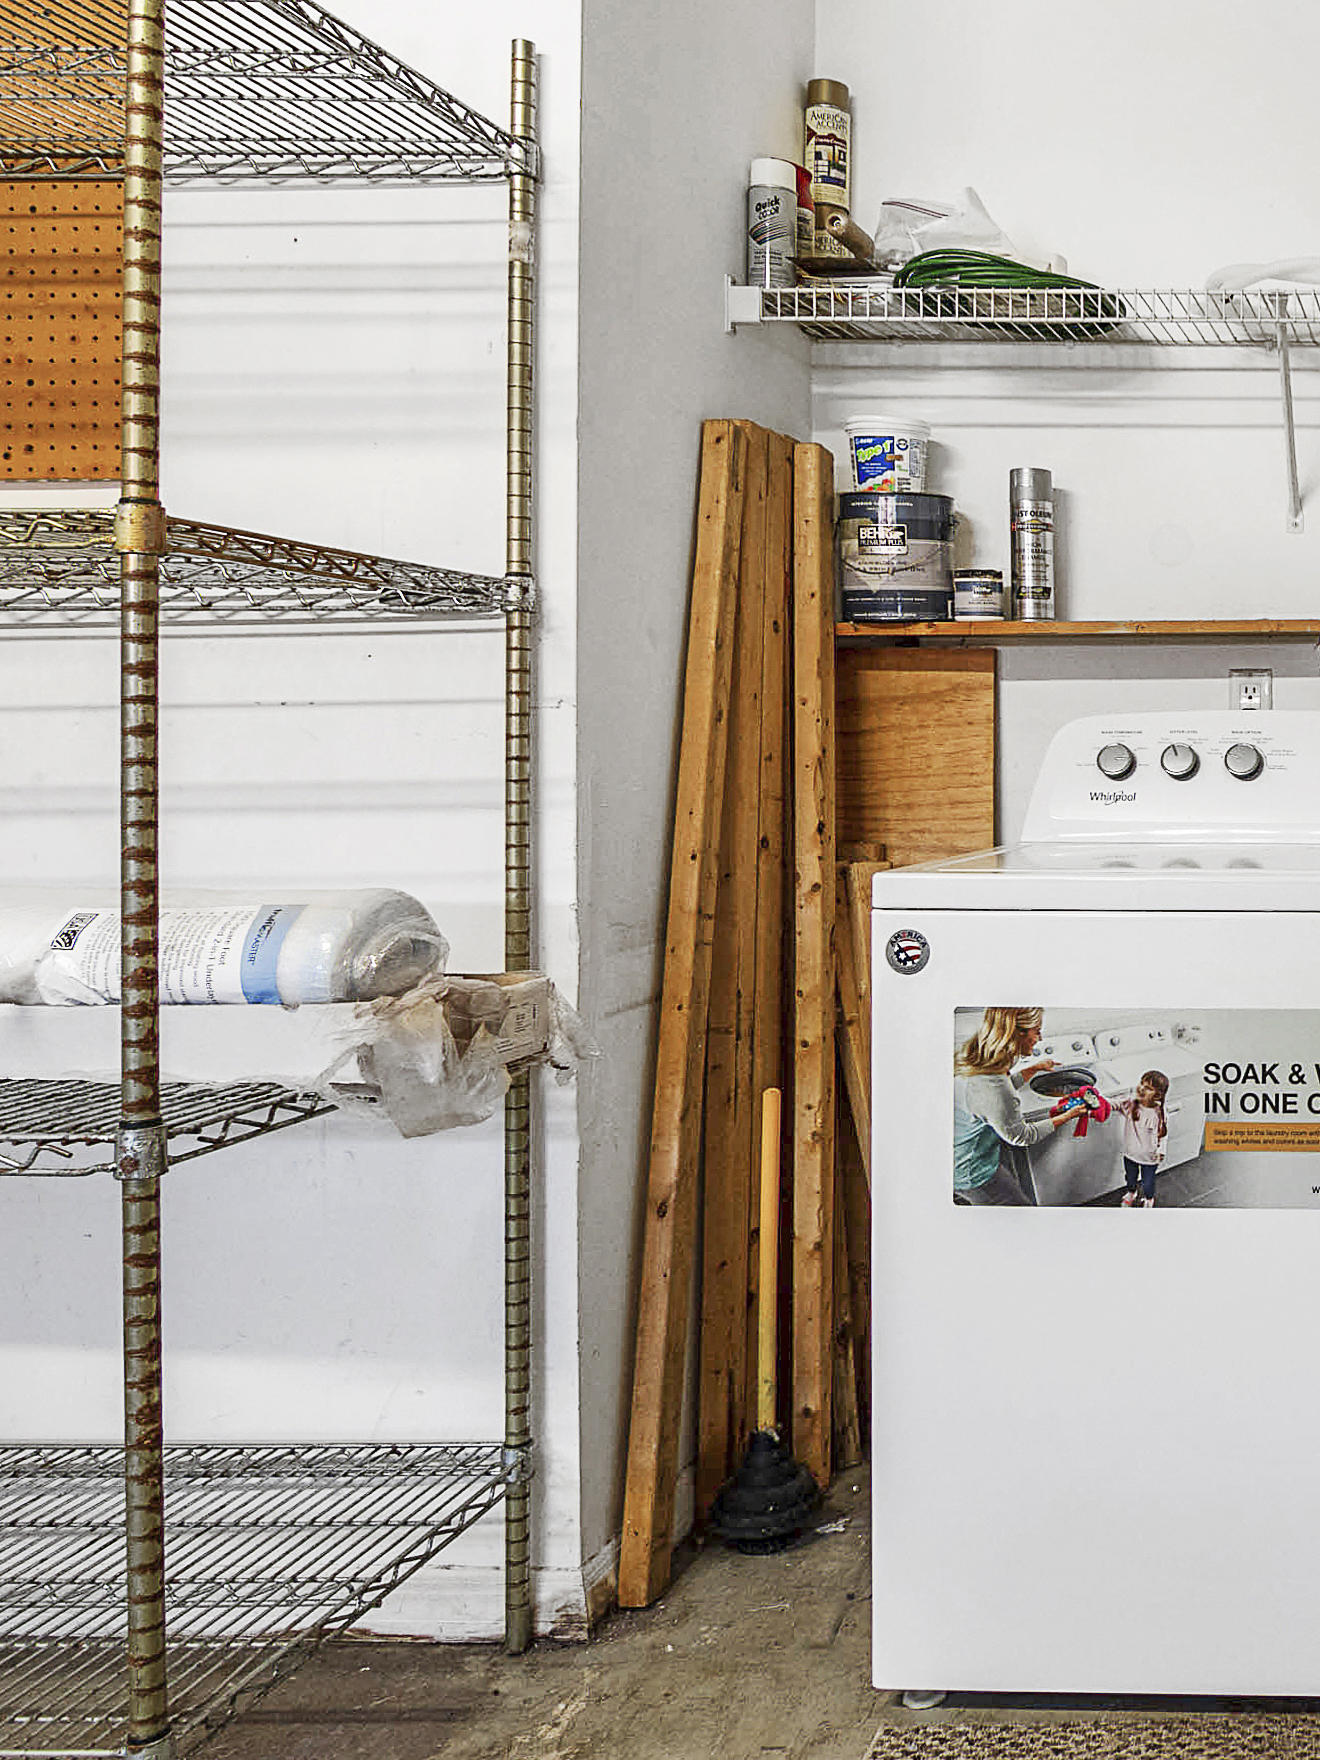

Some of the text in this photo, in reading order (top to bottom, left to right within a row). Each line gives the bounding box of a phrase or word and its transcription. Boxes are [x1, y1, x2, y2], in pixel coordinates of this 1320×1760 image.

[755, 195, 780, 213] Quick
[856, 445, 883, 463] Type
[859, 526, 892, 540] BEHR
[1089, 791, 1137, 805] Whirlpool
[218, 947, 230, 965] Foot
[206, 963, 218, 1002] Underlay
[1203, 1062, 1280, 1085] SOAK
[1288, 1063, 1307, 1085] &
[1204, 1092, 1231, 1114] IN
[1239, 1093, 1299, 1115] ONE
